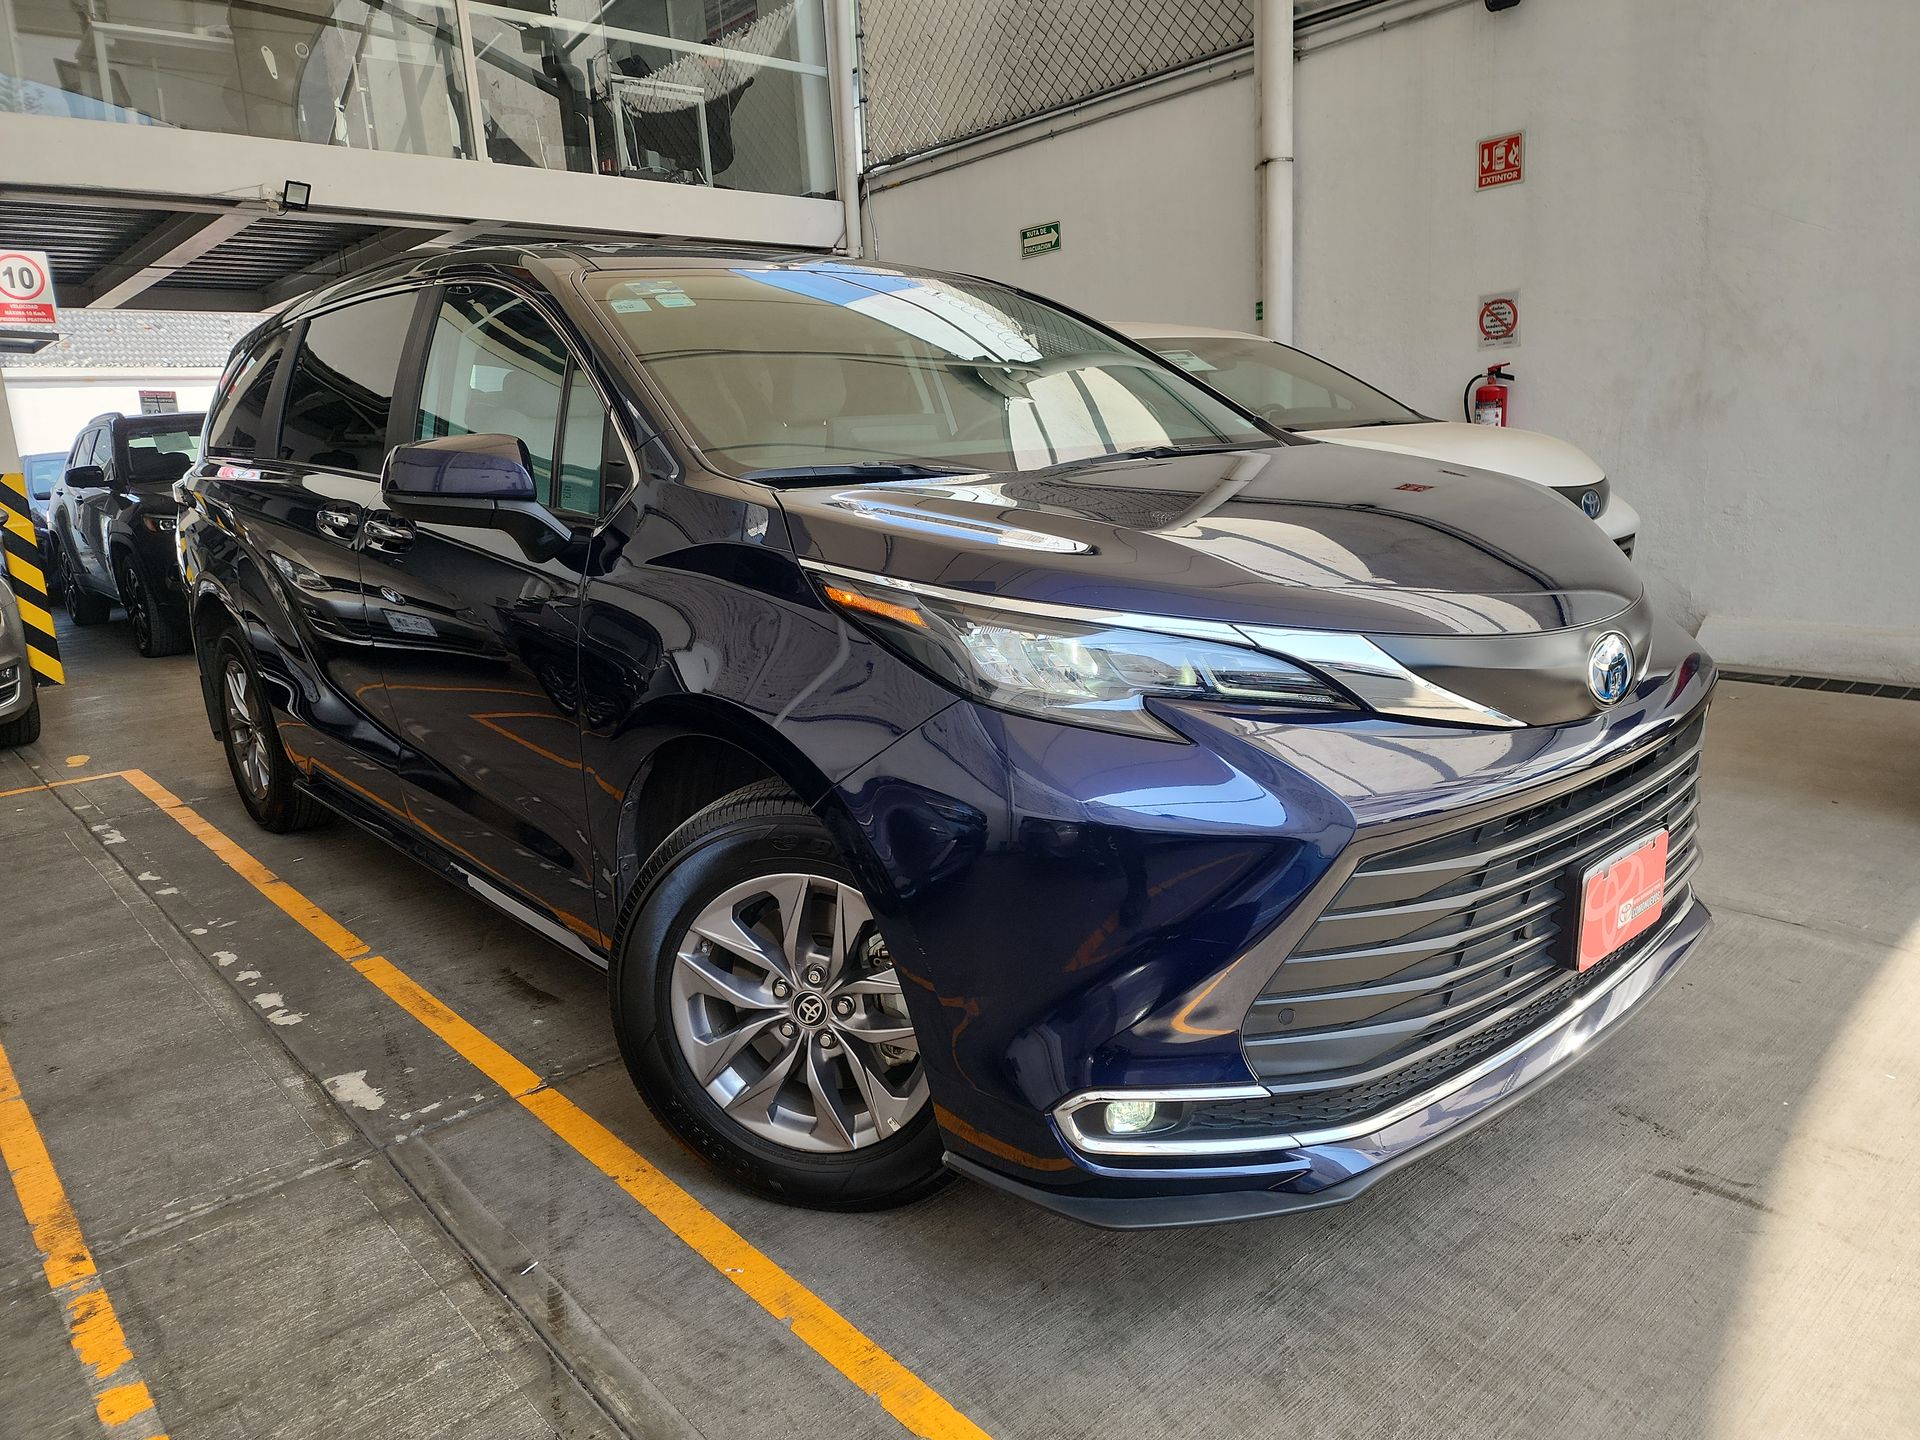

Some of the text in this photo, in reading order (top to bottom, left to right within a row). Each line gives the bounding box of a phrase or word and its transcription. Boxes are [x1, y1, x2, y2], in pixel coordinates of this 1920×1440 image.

[1482, 171, 1518, 185] EXTINTOR
[1026, 227, 1047, 238] RUTA DE
[2, 266, 34, 289] 10
